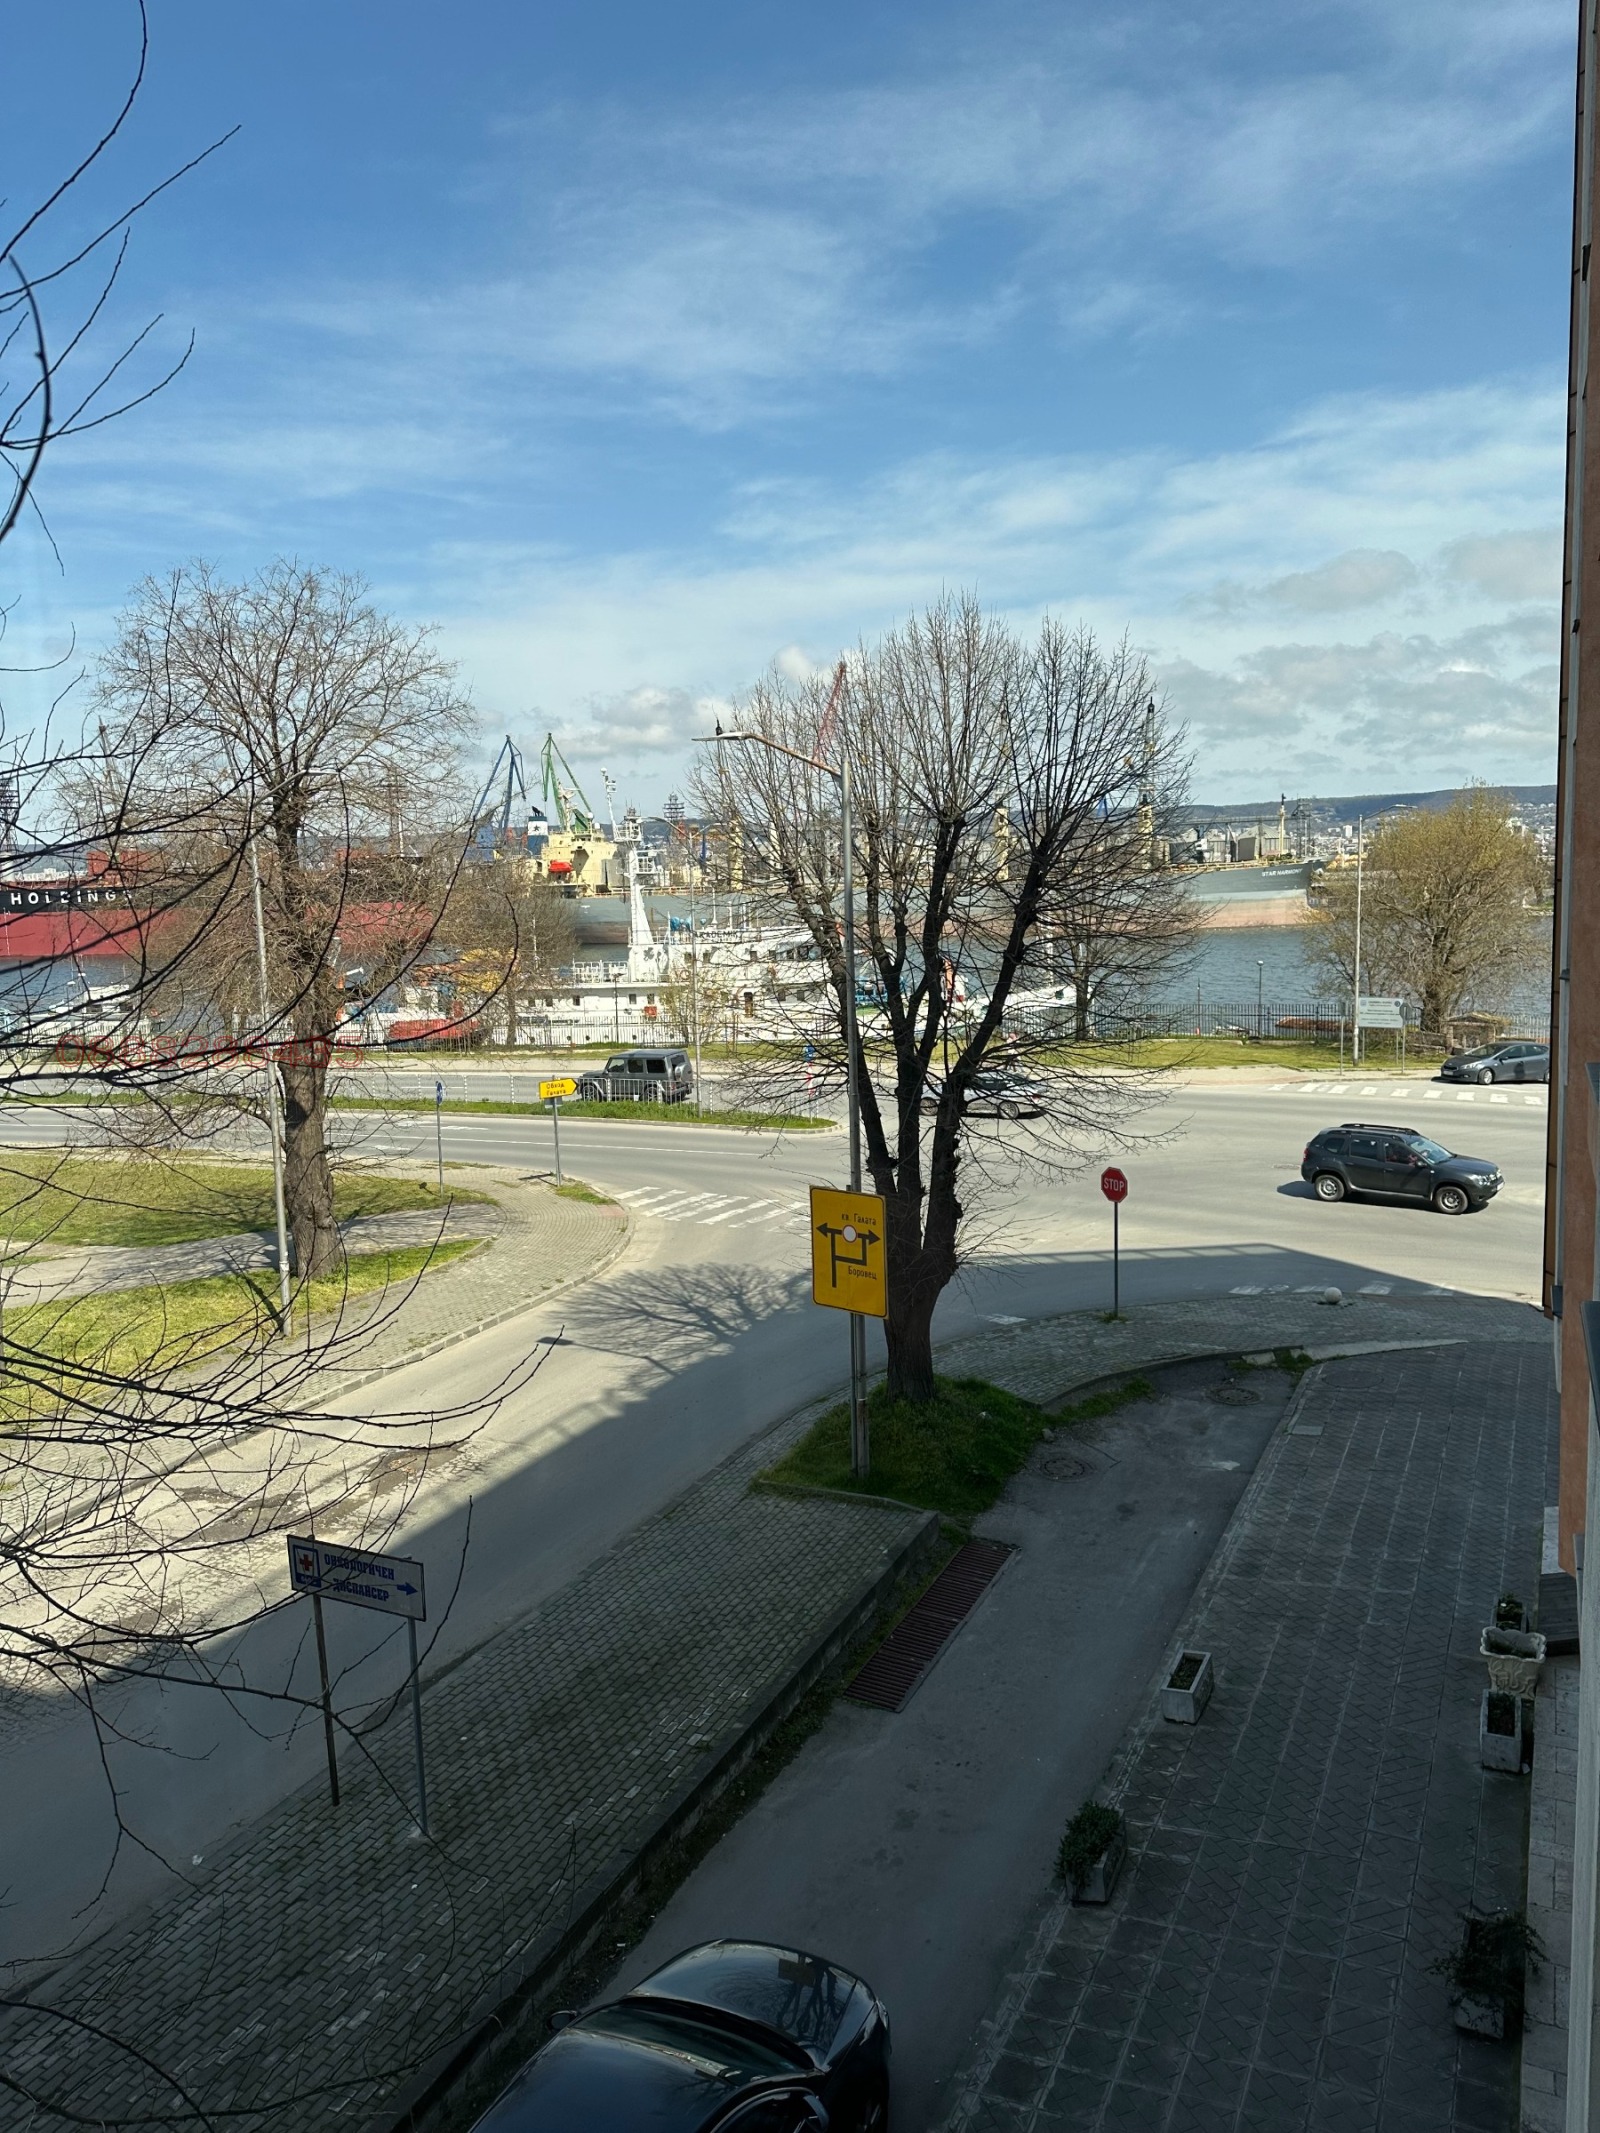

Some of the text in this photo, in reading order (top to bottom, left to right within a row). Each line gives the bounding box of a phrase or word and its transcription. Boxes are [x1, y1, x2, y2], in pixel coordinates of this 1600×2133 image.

[1103, 1178, 1125, 1192] STOP
[853, 1213, 877, 1226] Галата
[848, 1265, 877, 1280] Боровец
